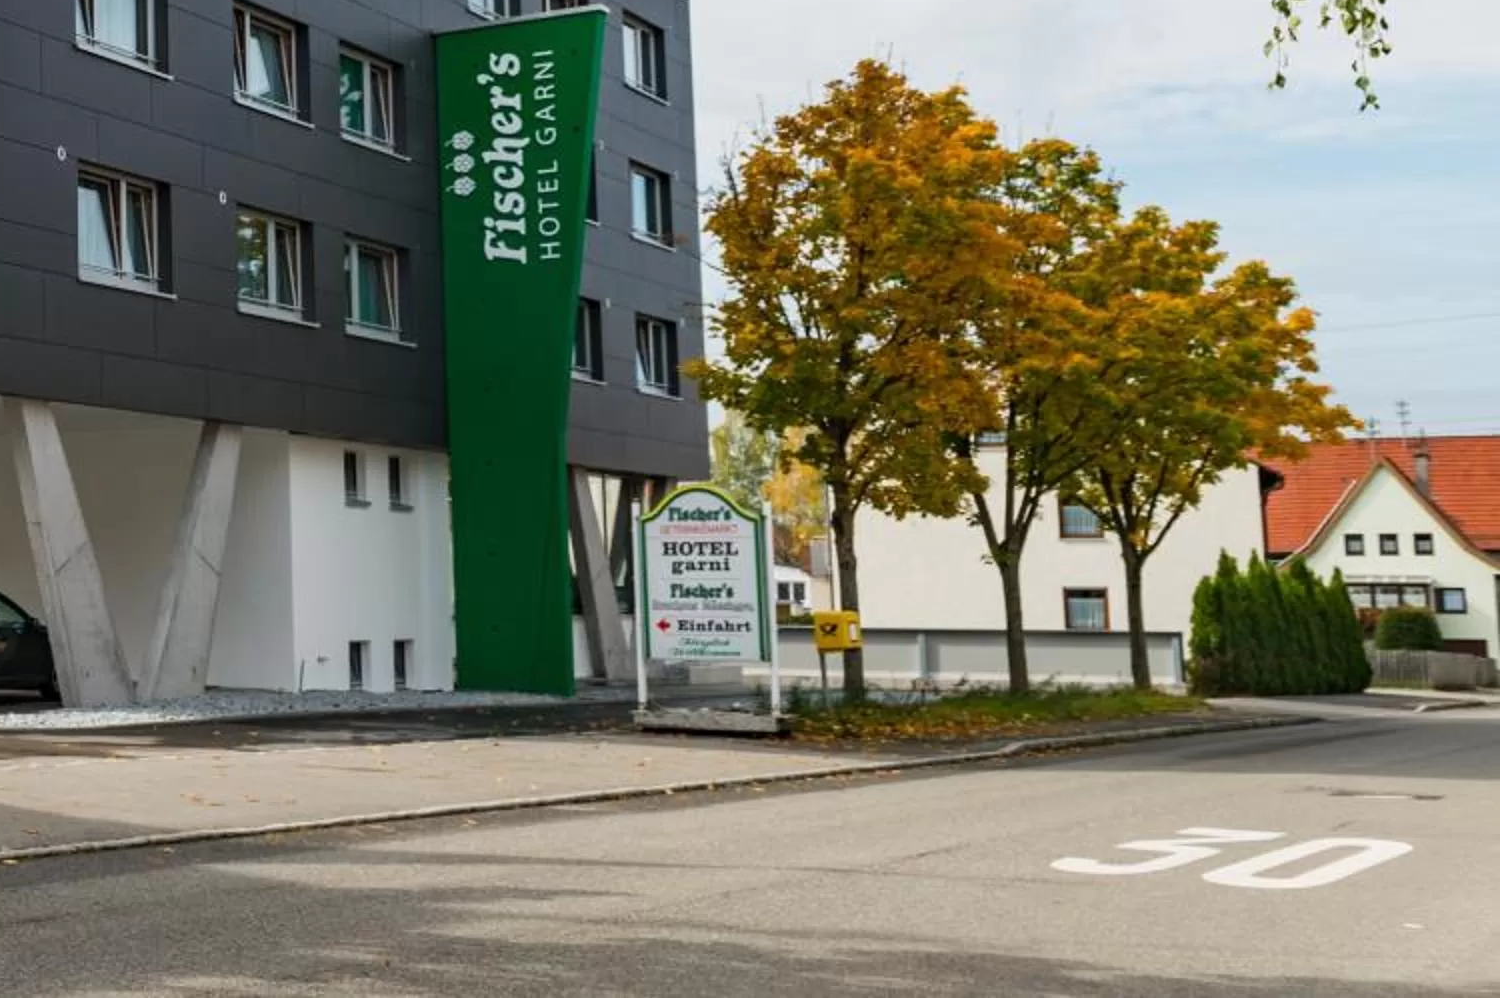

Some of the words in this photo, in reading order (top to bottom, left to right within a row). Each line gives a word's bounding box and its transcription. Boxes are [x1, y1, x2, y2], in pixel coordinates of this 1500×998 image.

[532, 49, 557, 146] GARNI
[476, 52, 530, 264] Fischer's
[537, 159, 561, 260] HOTEL
[662, 541, 739, 557] HOTEL
[671, 557, 731, 575] garni
[677, 619, 752, 633] Einfahrt
[1050, 826, 1413, 889] 30
